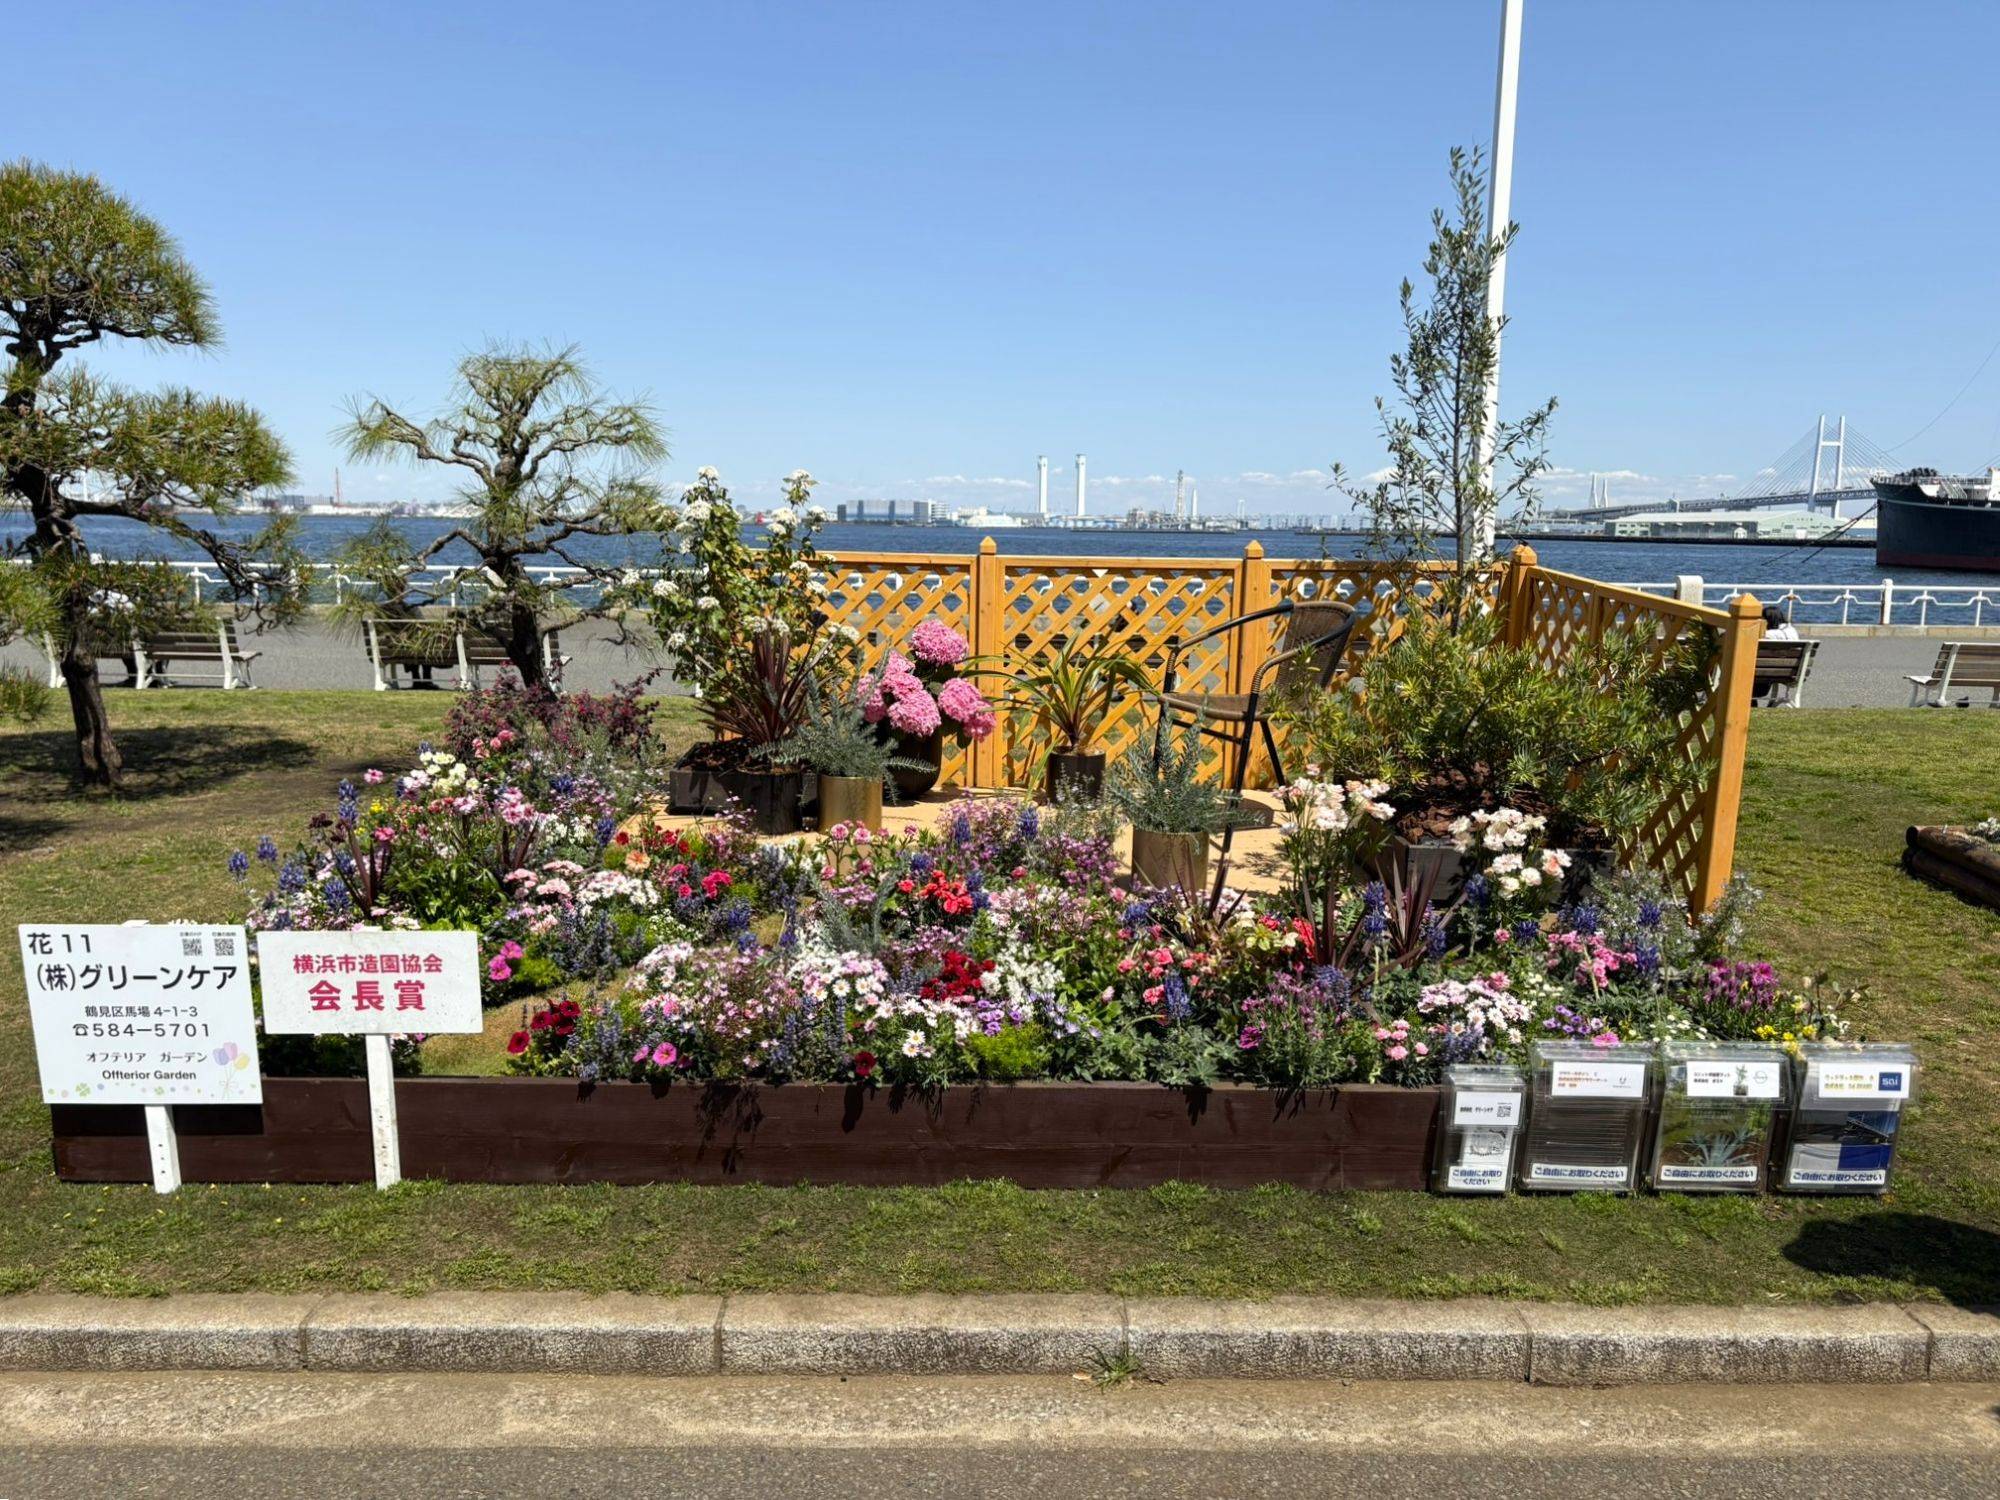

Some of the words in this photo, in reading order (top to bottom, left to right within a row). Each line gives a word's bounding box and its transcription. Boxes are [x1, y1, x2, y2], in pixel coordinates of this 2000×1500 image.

[27, 933, 53, 955] 花
[62, 934, 91, 953] 11
[293, 954, 443, 974] 横浜市造園協会
[37, 964, 238, 991] (株)グリーンケア
[308, 980, 426, 1012] 会長賞
[85, 1006, 151, 1018] 鶴見区馬場
[86, 1052, 147, 1063] オフテリア
[160, 1052, 208, 1063] ガーデン
[154, 1070, 197, 1080] Garden
[1452, 1169, 1502, 1178] ご自由にお取り
[1534, 1166, 1624, 1178] ご自由にお取りください
[1663, 1169, 1754, 1179] ご自由にお取りください
[1793, 1172, 1883, 1182] ご自由にお取りください
